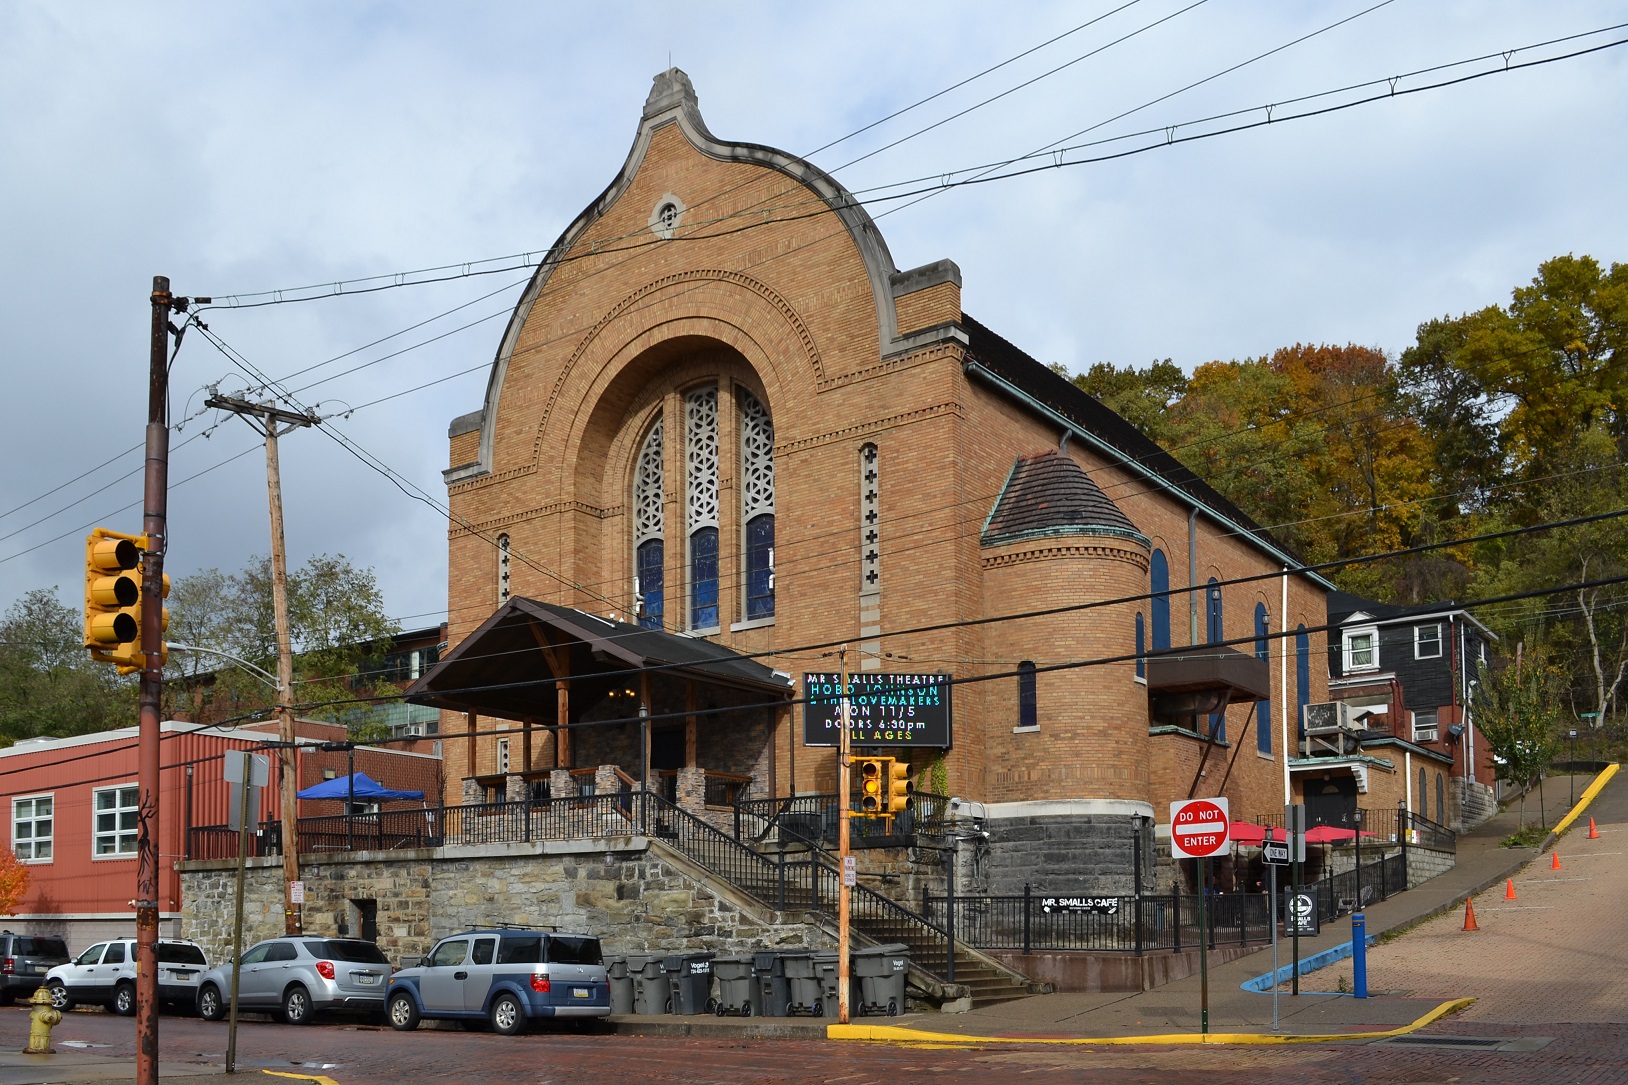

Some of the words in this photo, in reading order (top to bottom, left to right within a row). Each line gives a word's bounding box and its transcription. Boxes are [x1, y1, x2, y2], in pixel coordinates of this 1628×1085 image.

[807, 674, 826, 683] MR
[834, 674, 884, 684] SALLS
[852, 696, 941, 706] LOVEMAKERS
[878, 719, 925, 731] 6:30pm
[873, 730, 913, 740] AGES
[1179, 812, 1194, 822] DO
[1199, 809, 1219, 820] NOT
[1184, 835, 1217, 847] ENTER
[1269, 848, 1278, 858] ONE
[1278, 849, 1287, 859] WAY
[1041, 898, 1057, 906] MR.
[1059, 898, 1094, 907] SMALLS
